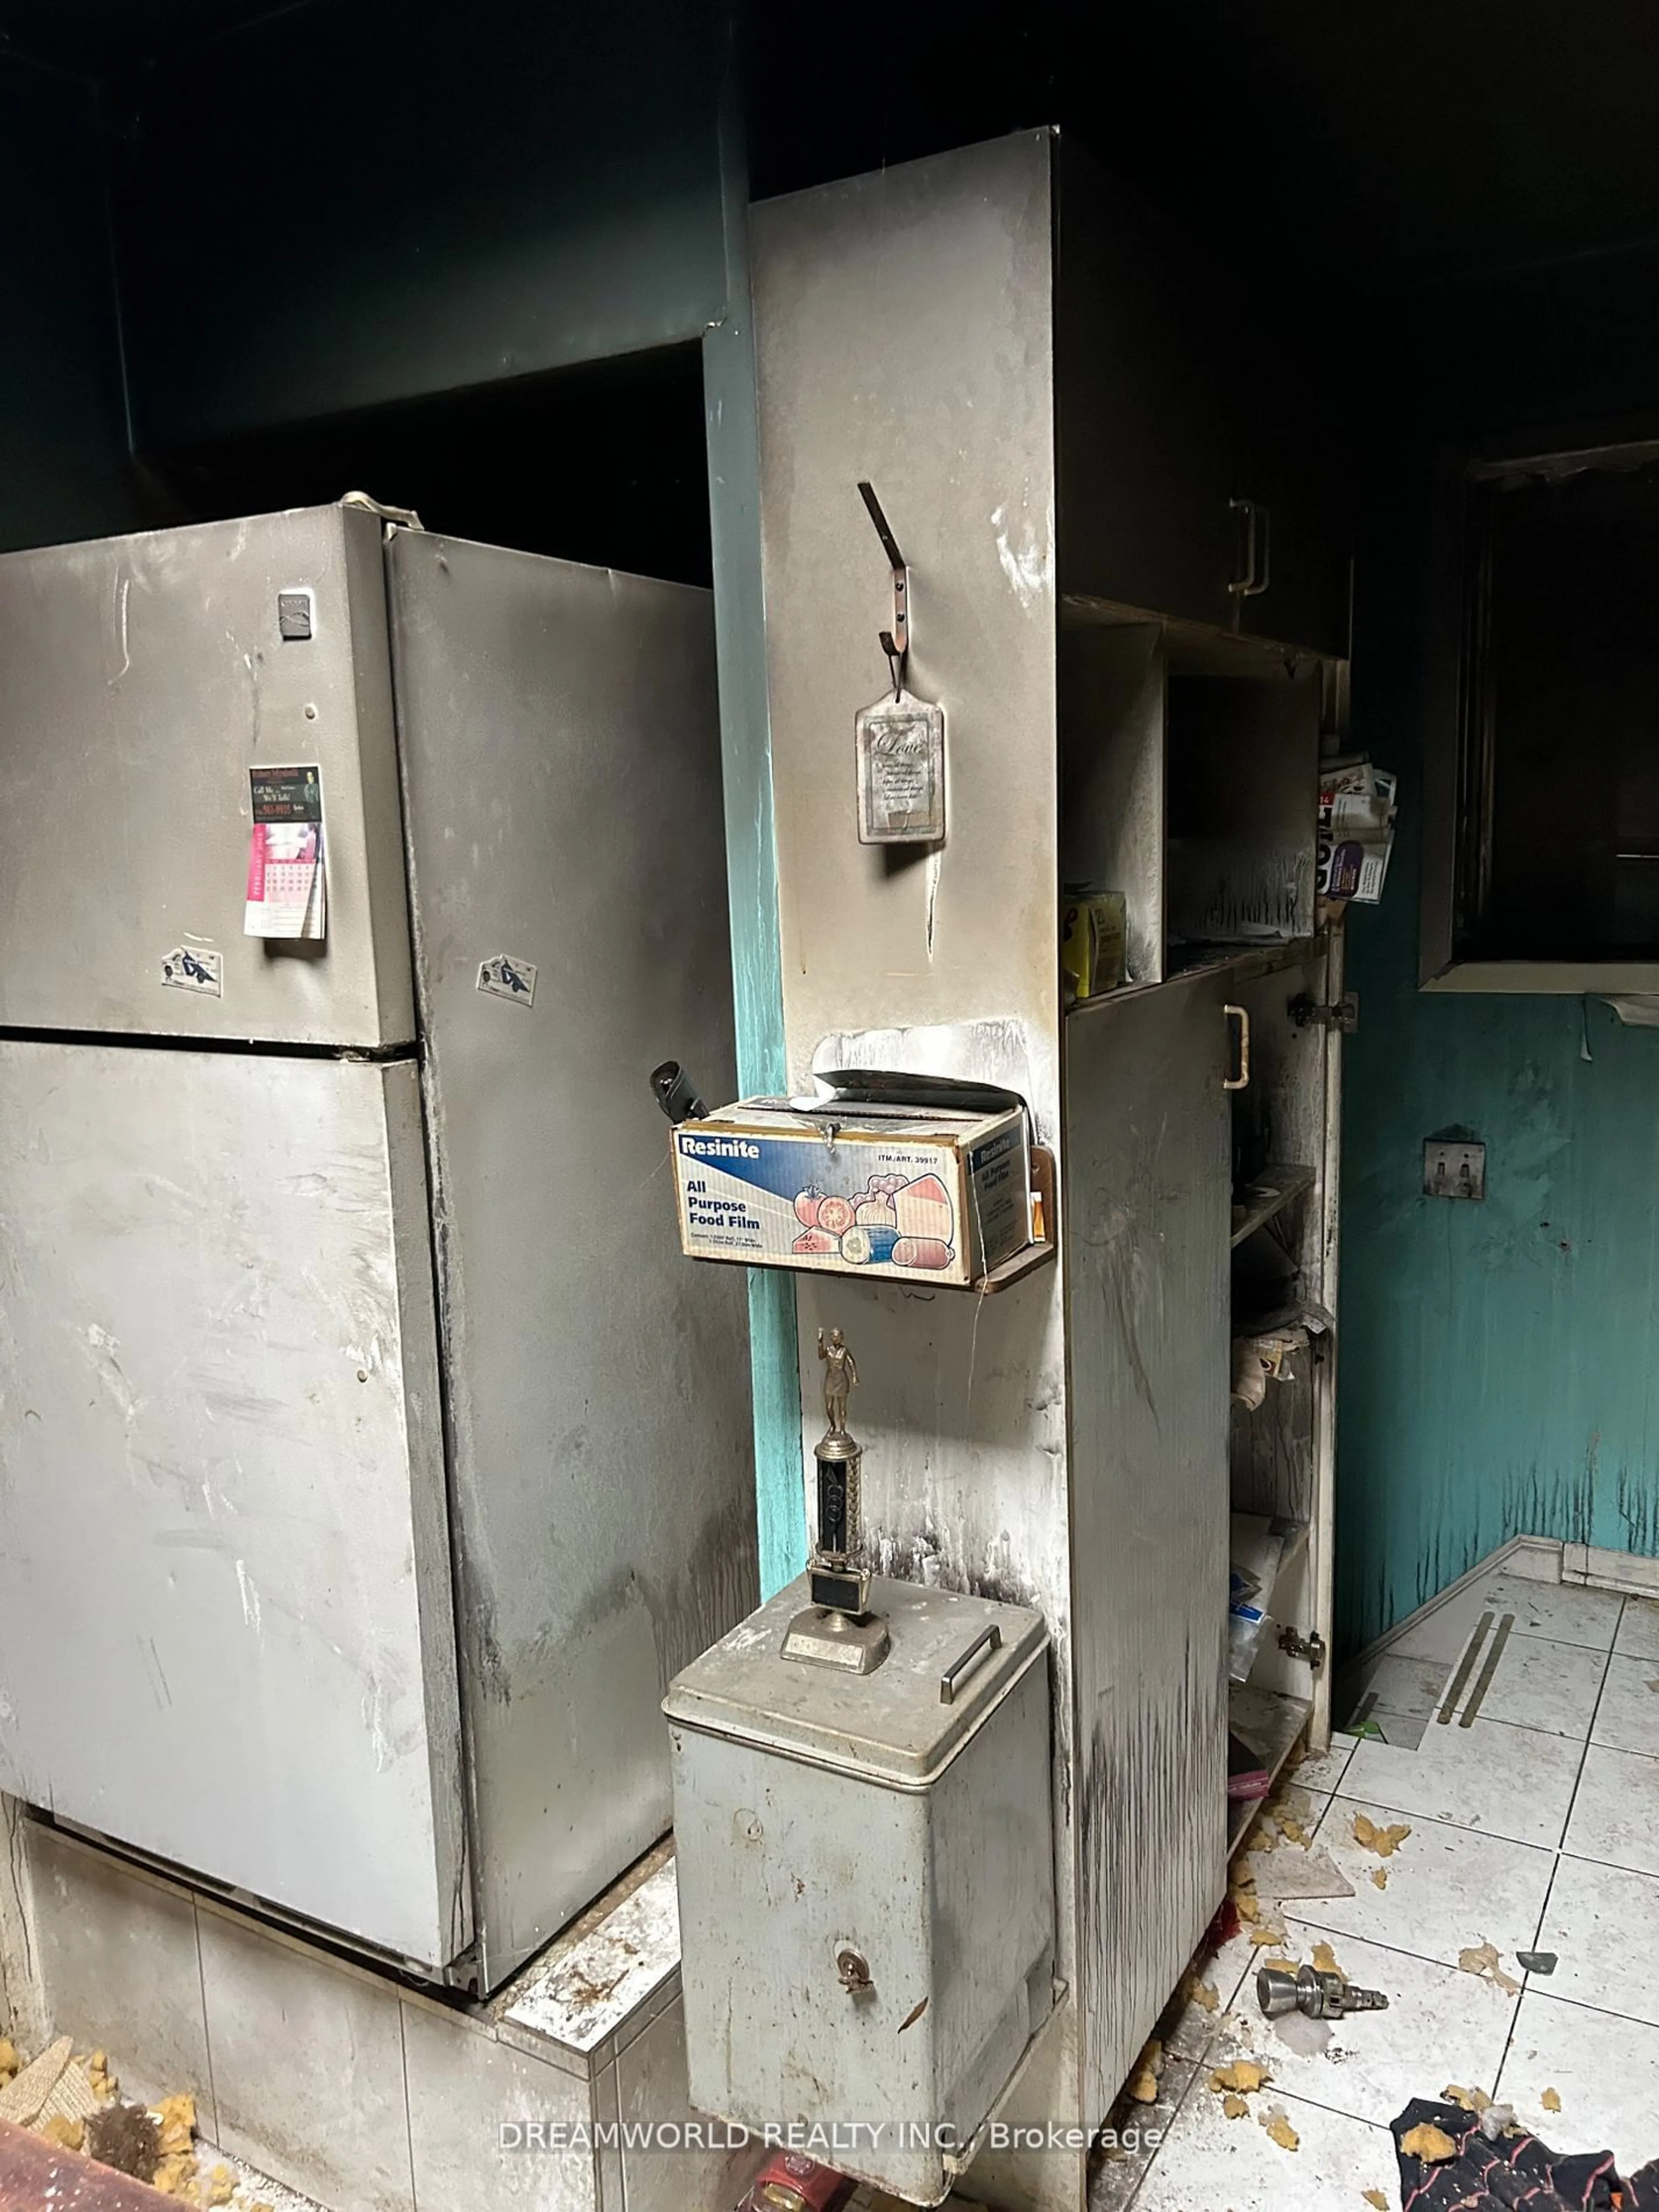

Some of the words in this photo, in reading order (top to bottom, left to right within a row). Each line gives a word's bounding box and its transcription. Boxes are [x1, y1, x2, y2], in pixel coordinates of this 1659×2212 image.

[681, 1137, 760, 1159] Resinite
[686, 1180, 706, 1193] All
[688, 1196, 746, 1213] Purpose
[690, 1212, 724, 1227] Food
[728, 1216, 760, 1230] Film
